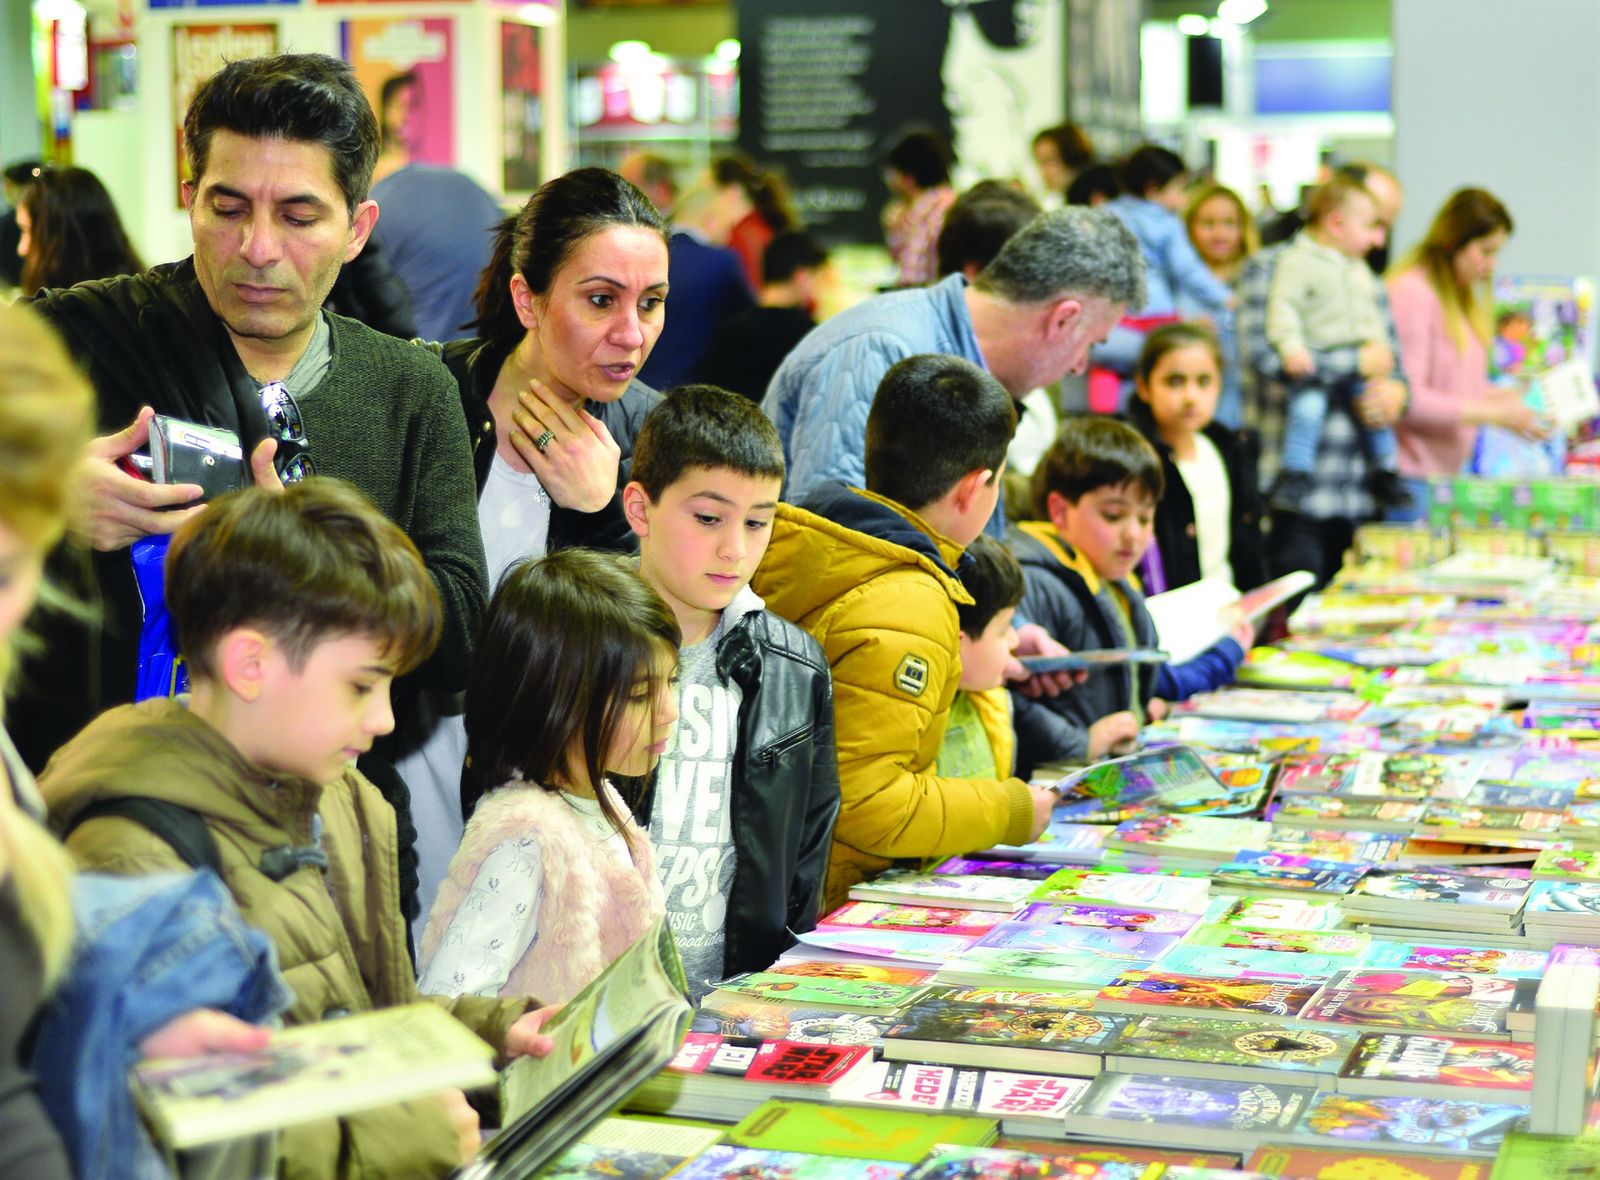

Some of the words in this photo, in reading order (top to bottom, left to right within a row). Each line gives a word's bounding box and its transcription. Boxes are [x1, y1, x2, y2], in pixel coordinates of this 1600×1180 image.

[667, 911, 698, 931] USIC
[761, 1046, 810, 1078] WARS
[787, 1046, 841, 1080] STAR
[991, 1079, 1046, 1112] WARS
[1023, 1079, 1070, 1112] STAR
